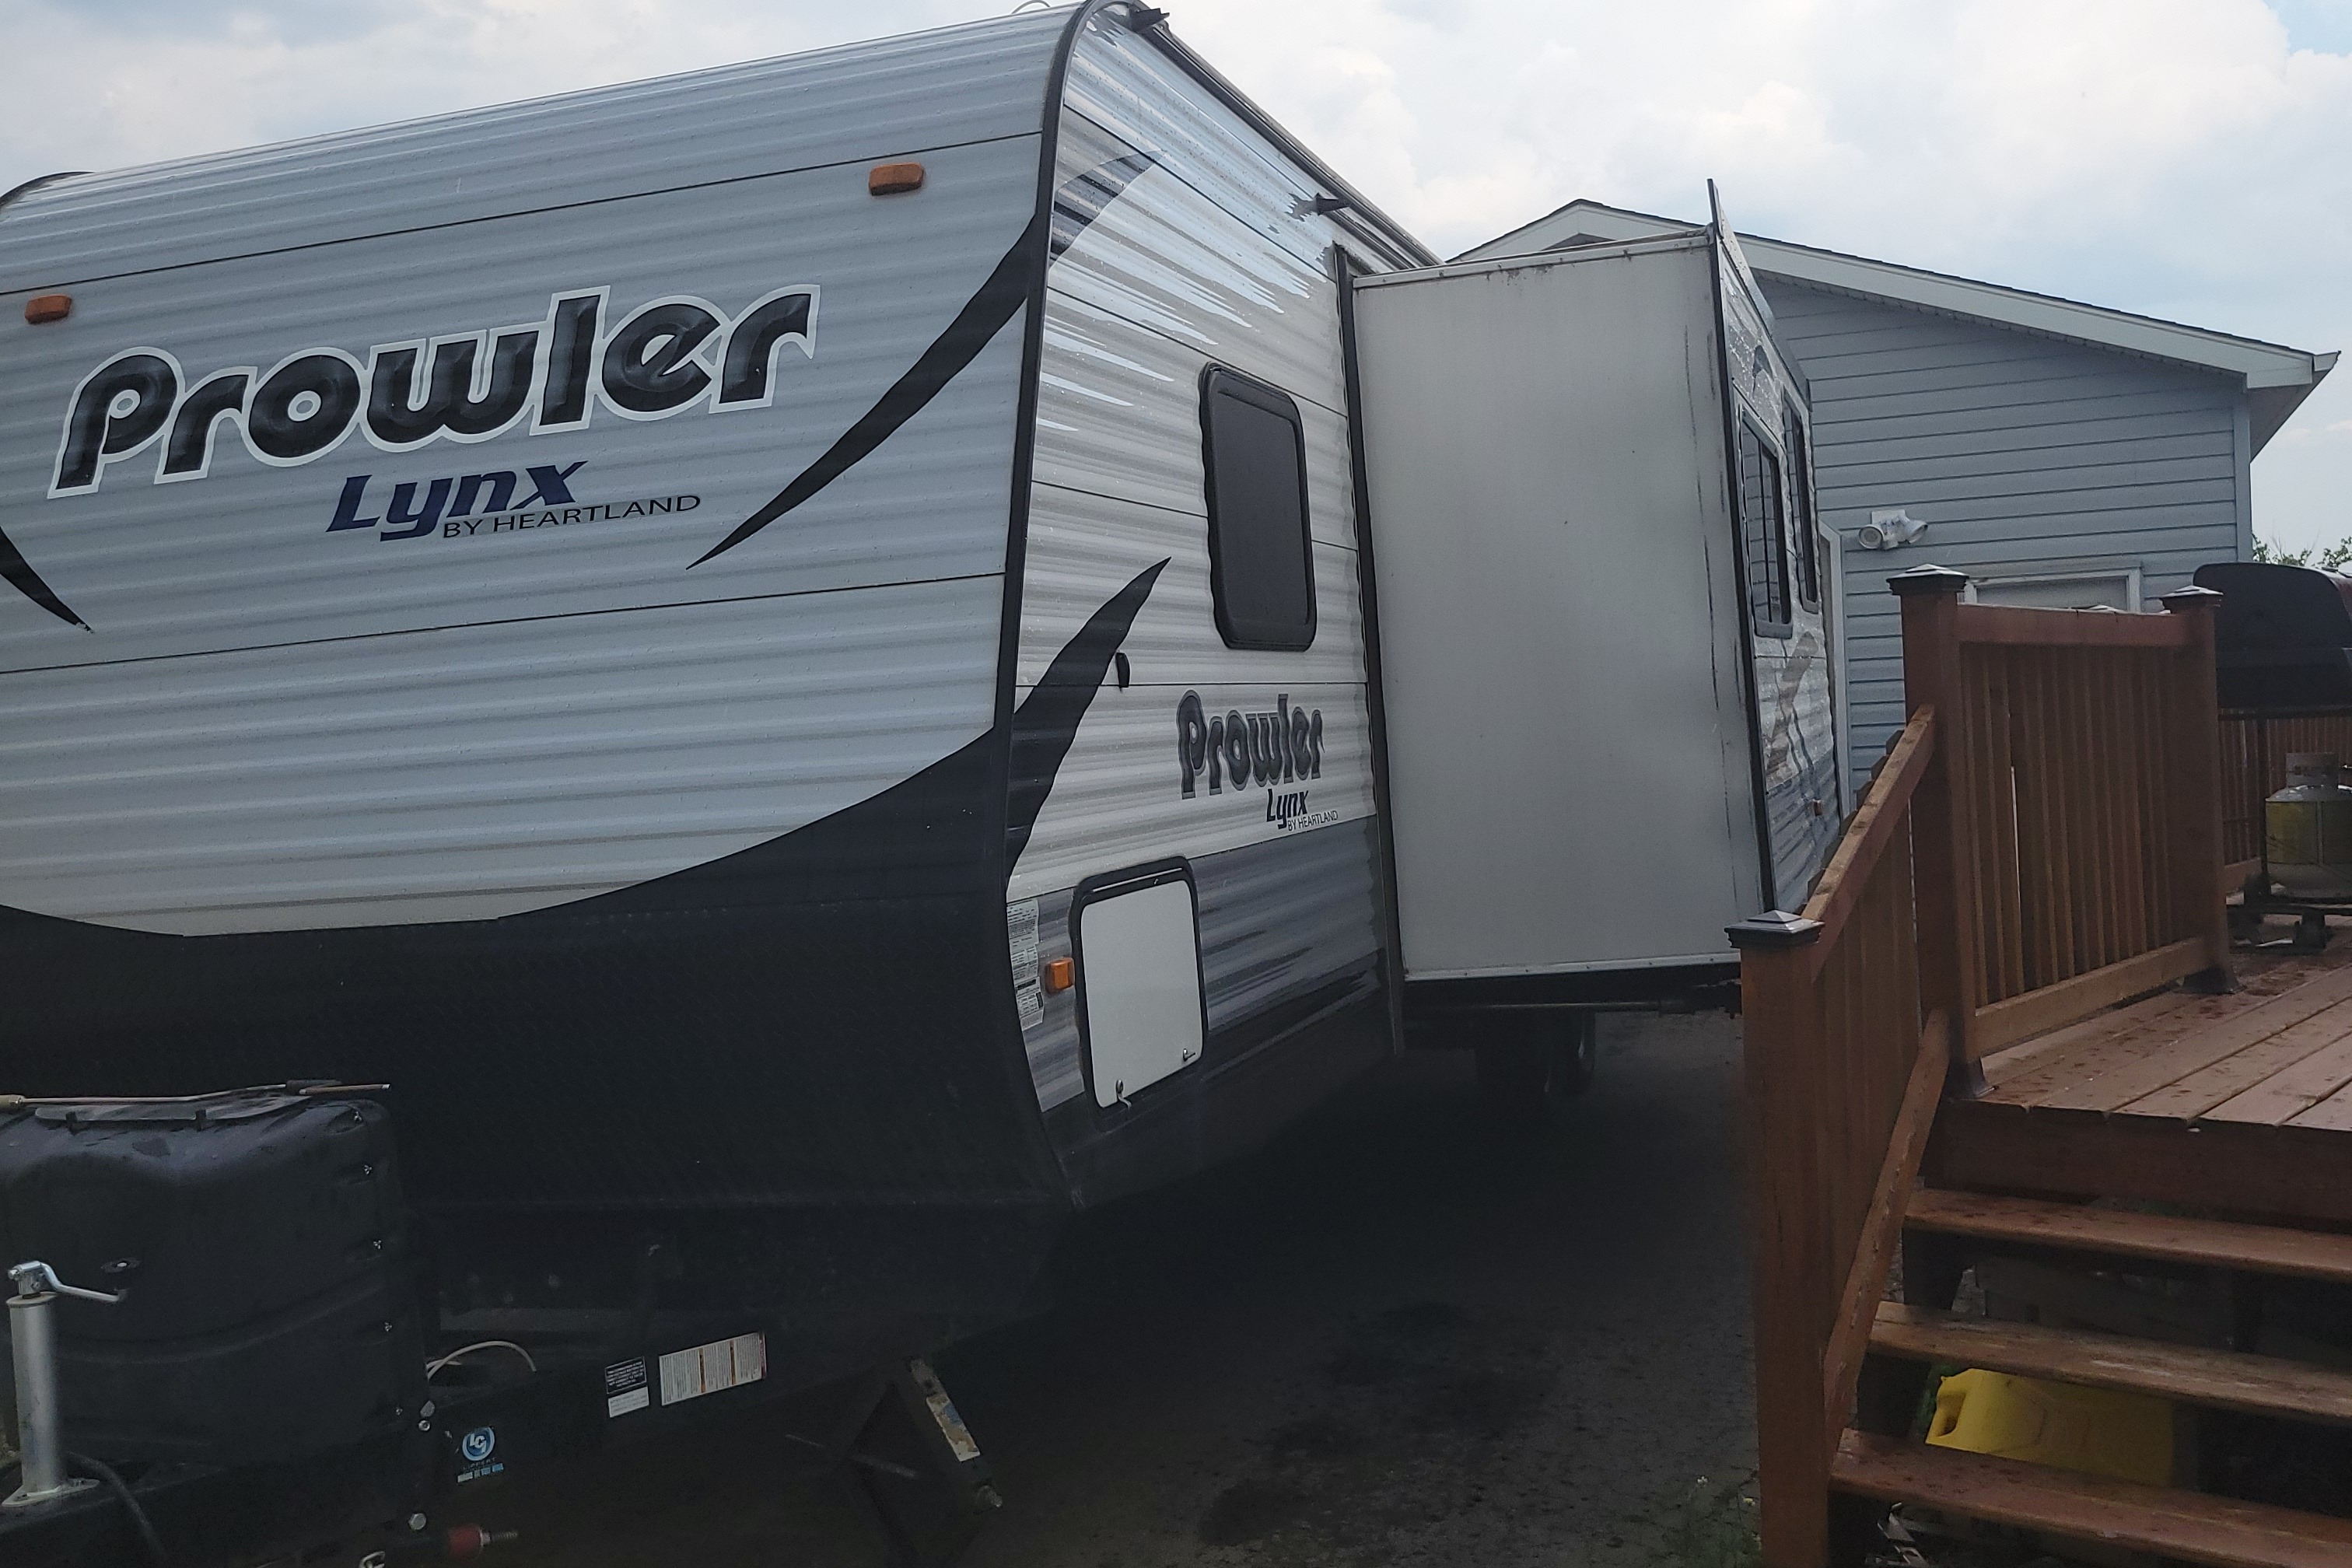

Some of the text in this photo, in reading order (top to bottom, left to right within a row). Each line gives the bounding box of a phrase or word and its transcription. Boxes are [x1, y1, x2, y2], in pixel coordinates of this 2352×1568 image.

[48, 285, 820, 498] Prowler
[326, 460, 588, 541] Lynx
[443, 495, 700, 538] BY HEARTLAND
[1177, 690, 1325, 799] Prowler
[1266, 789, 1309, 829] Lynx
[1287, 810, 1338, 831] BY HEARTLAND
